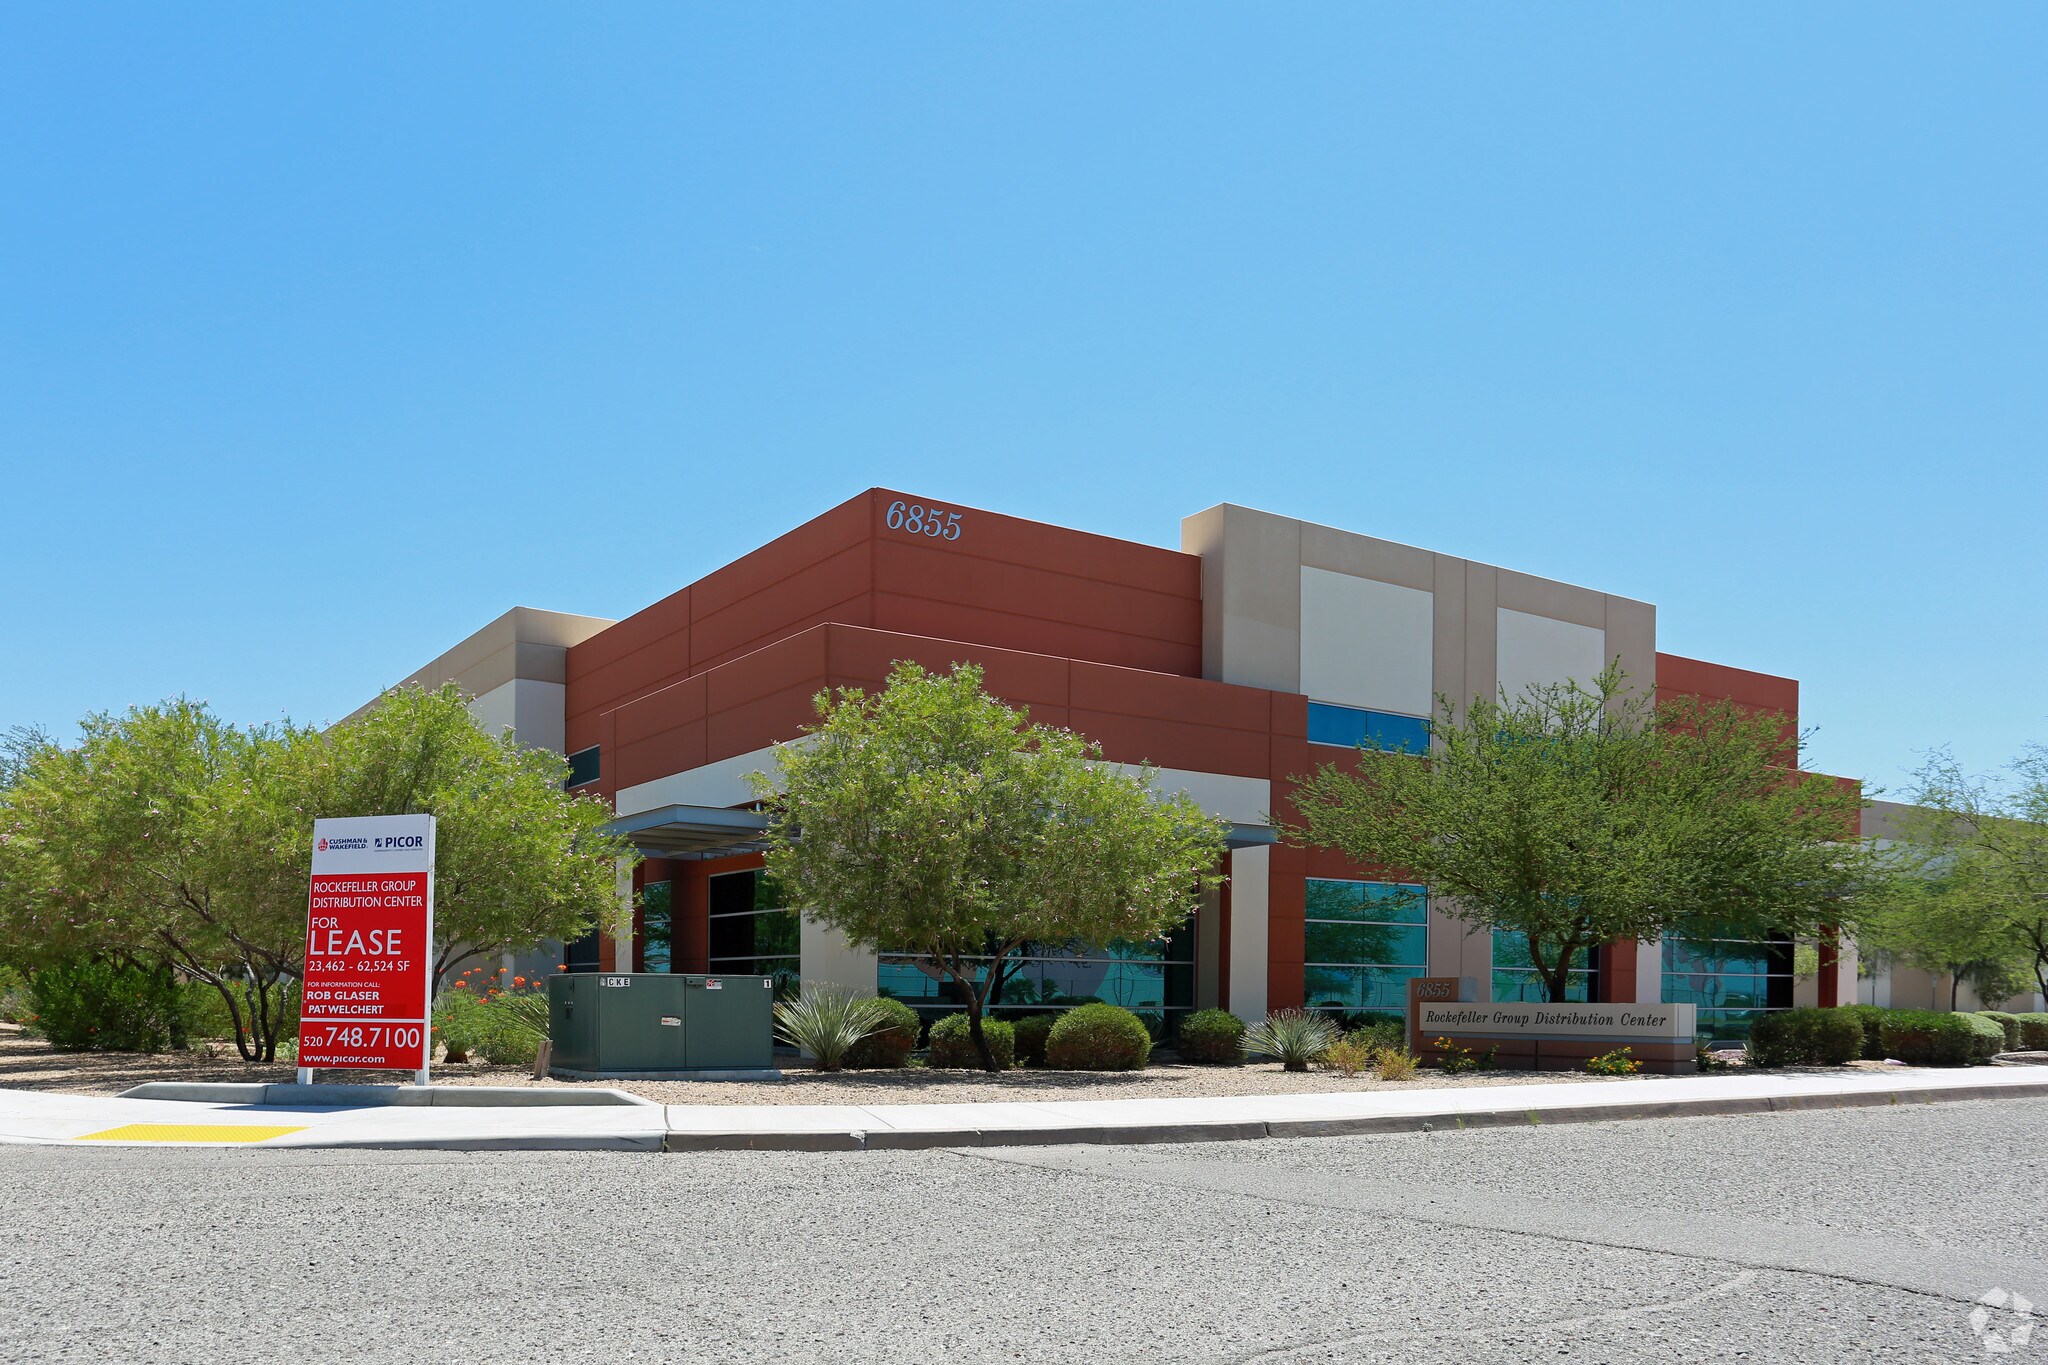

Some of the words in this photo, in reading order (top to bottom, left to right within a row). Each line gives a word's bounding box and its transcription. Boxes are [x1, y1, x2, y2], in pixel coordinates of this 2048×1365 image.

[886, 500, 963, 541] 6855
[385, 836, 423, 848] PICOR
[314, 881, 379, 893] ROCKEFELLER
[381, 880, 416, 892] GROUP
[313, 896, 381, 908] DISTRIBUTION
[384, 895, 423, 907] CENTER
[311, 917, 339, 929] FOR
[310, 929, 402, 955] LEASE
[309, 960, 345, 972] 23,462
[357, 960, 394, 973] 62,524
[397, 960, 410, 971] SF
[306, 991, 331, 1000] ROB
[334, 991, 380, 1000] GLASER
[1416, 982, 1451, 998] 6855
[308, 1005, 327, 1014] PAT
[328, 1005, 384, 1014] WELCHERT
[1426, 1010, 1488, 1026] Rockefeller
[1493, 1011, 1529, 1027] Group
[1534, 1011, 1614, 1026] Distribution
[1620, 1012, 1667, 1026] Center
[303, 1036, 323, 1047] 520
[325, 1026, 420, 1048] 748.7100
[303, 1054, 385, 1065] www.picor.com
